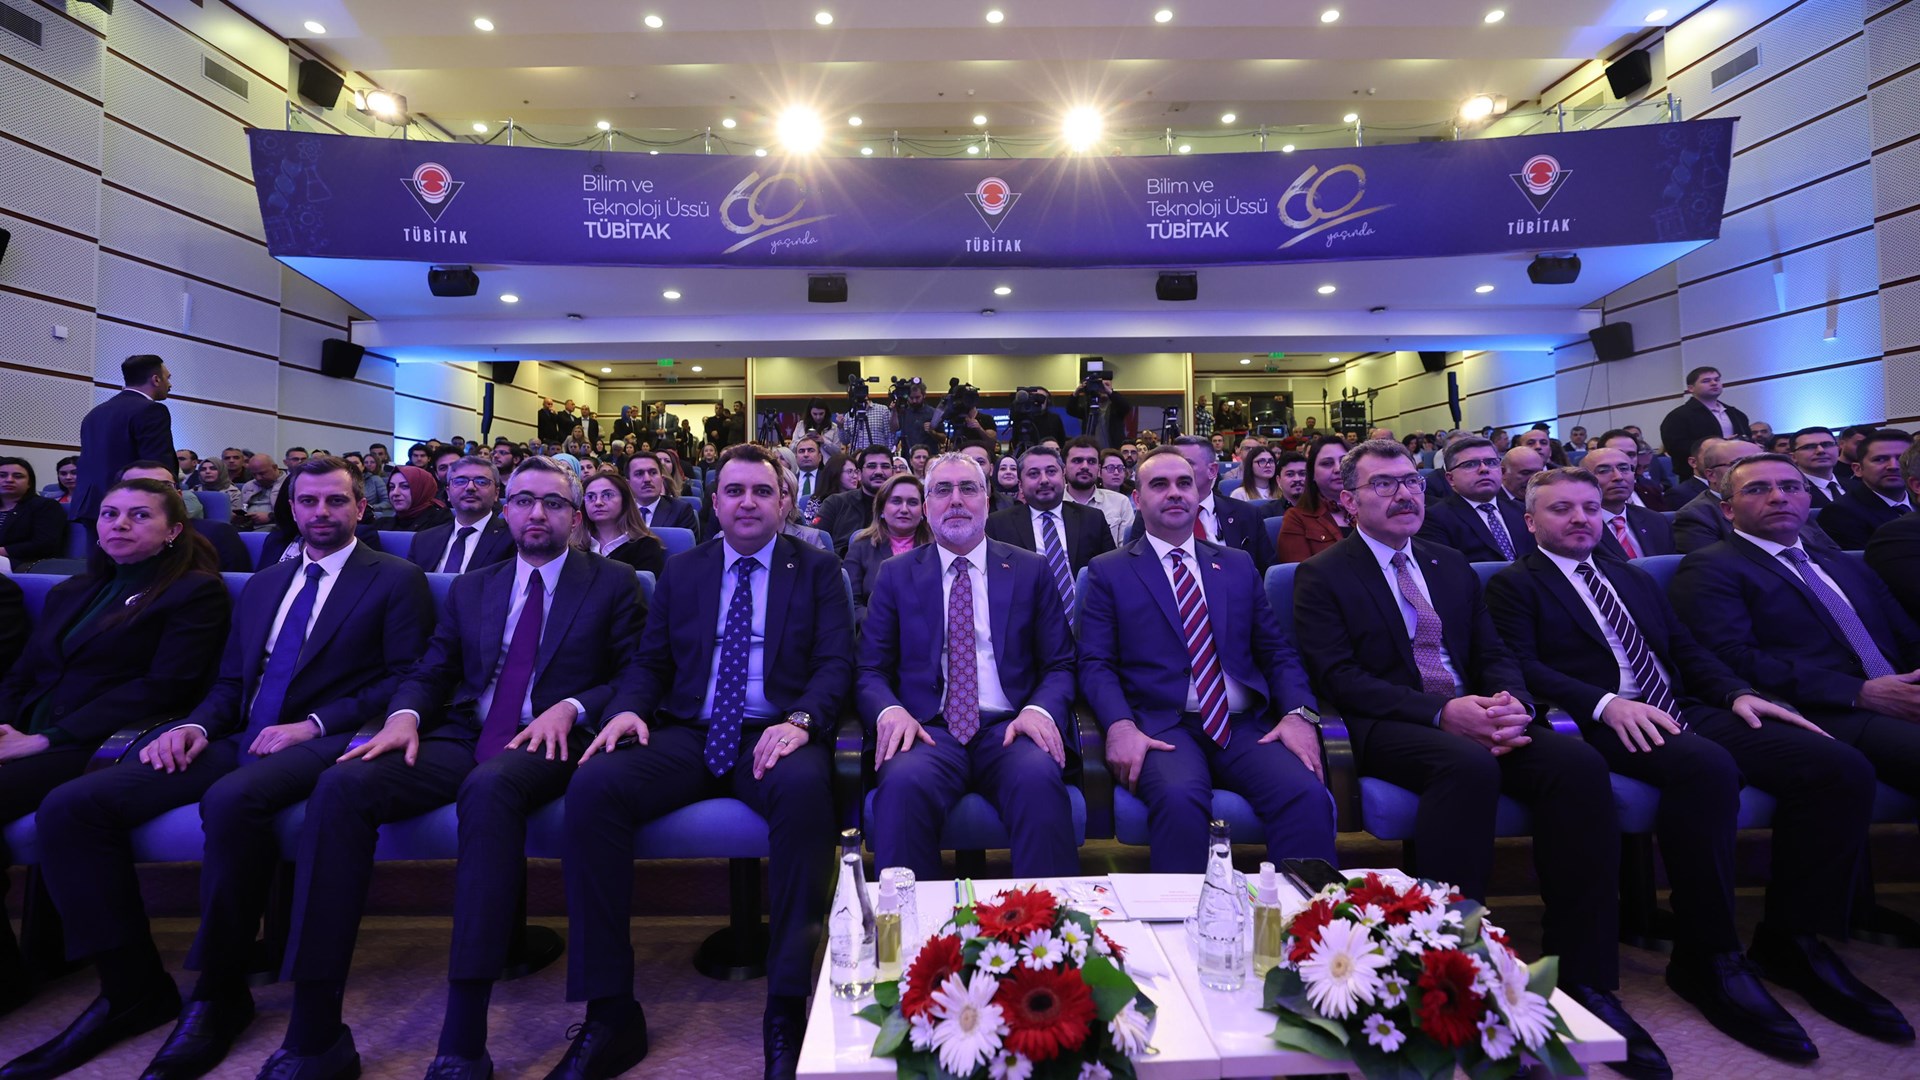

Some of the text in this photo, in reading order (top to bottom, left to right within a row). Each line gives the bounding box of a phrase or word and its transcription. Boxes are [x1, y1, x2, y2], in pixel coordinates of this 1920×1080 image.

[583, 174, 654, 193] Bilim ve
[1147, 178, 1214, 194] Bilim ve
[719, 171, 808, 235] 60
[1147, 196, 1268, 218] Teknoloji Üssü
[1278, 163, 1367, 229] 60
[583, 197, 710, 219] Teknoloji Üssü
[403, 226, 468, 244] TÜBİTAK
[583, 218, 672, 240] TÜBİTAK
[1147, 219, 1229, 239] TÜBİTAK
[1326, 222, 1376, 248] yaşında
[1508, 217, 1570, 235] TÜBİTAK
[770, 230, 818, 254] yaşında
[965, 236, 1021, 252] TÜBİTAK
